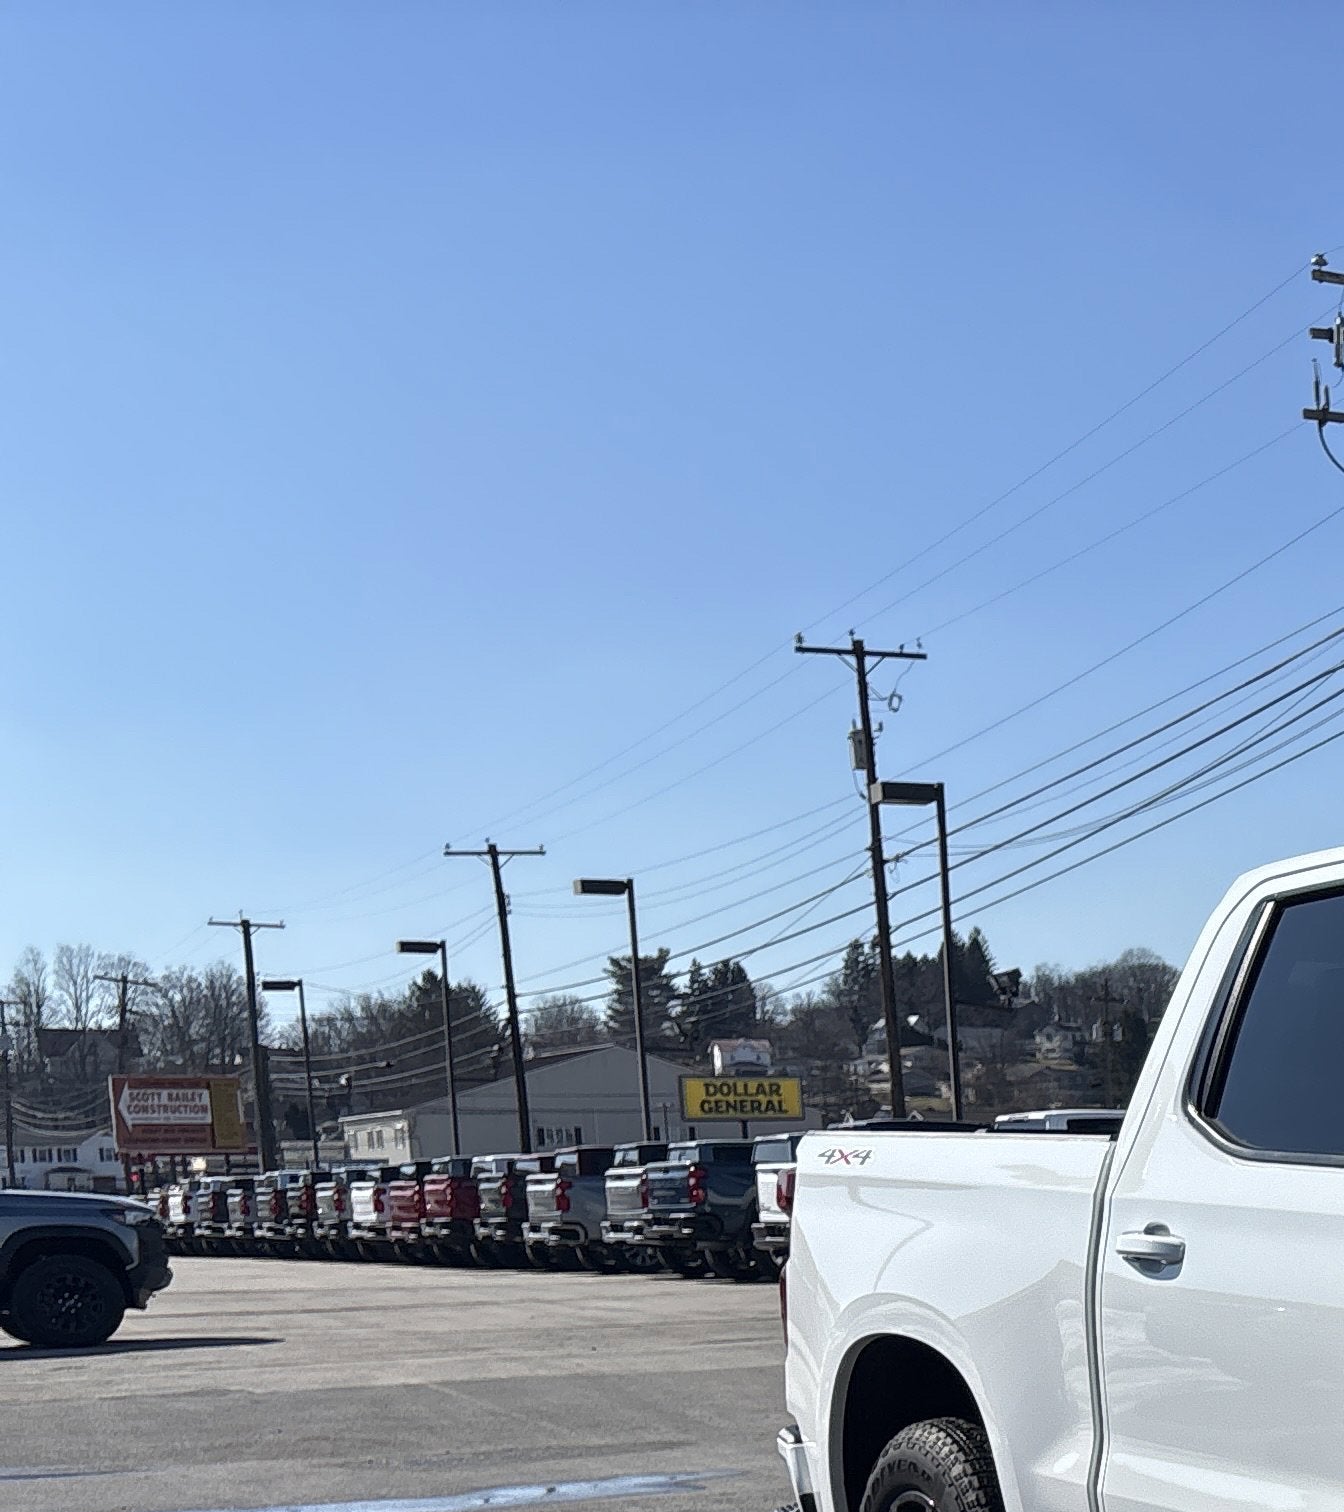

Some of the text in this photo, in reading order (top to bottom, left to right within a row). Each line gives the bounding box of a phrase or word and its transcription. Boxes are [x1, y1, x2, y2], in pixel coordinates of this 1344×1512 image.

[703, 1081, 782, 1097] DOLLAR
[128, 1091, 161, 1103] SCOTT
[126, 1103, 209, 1115] CONSTRUCTION
[700, 1098, 789, 1114] GENERAL
